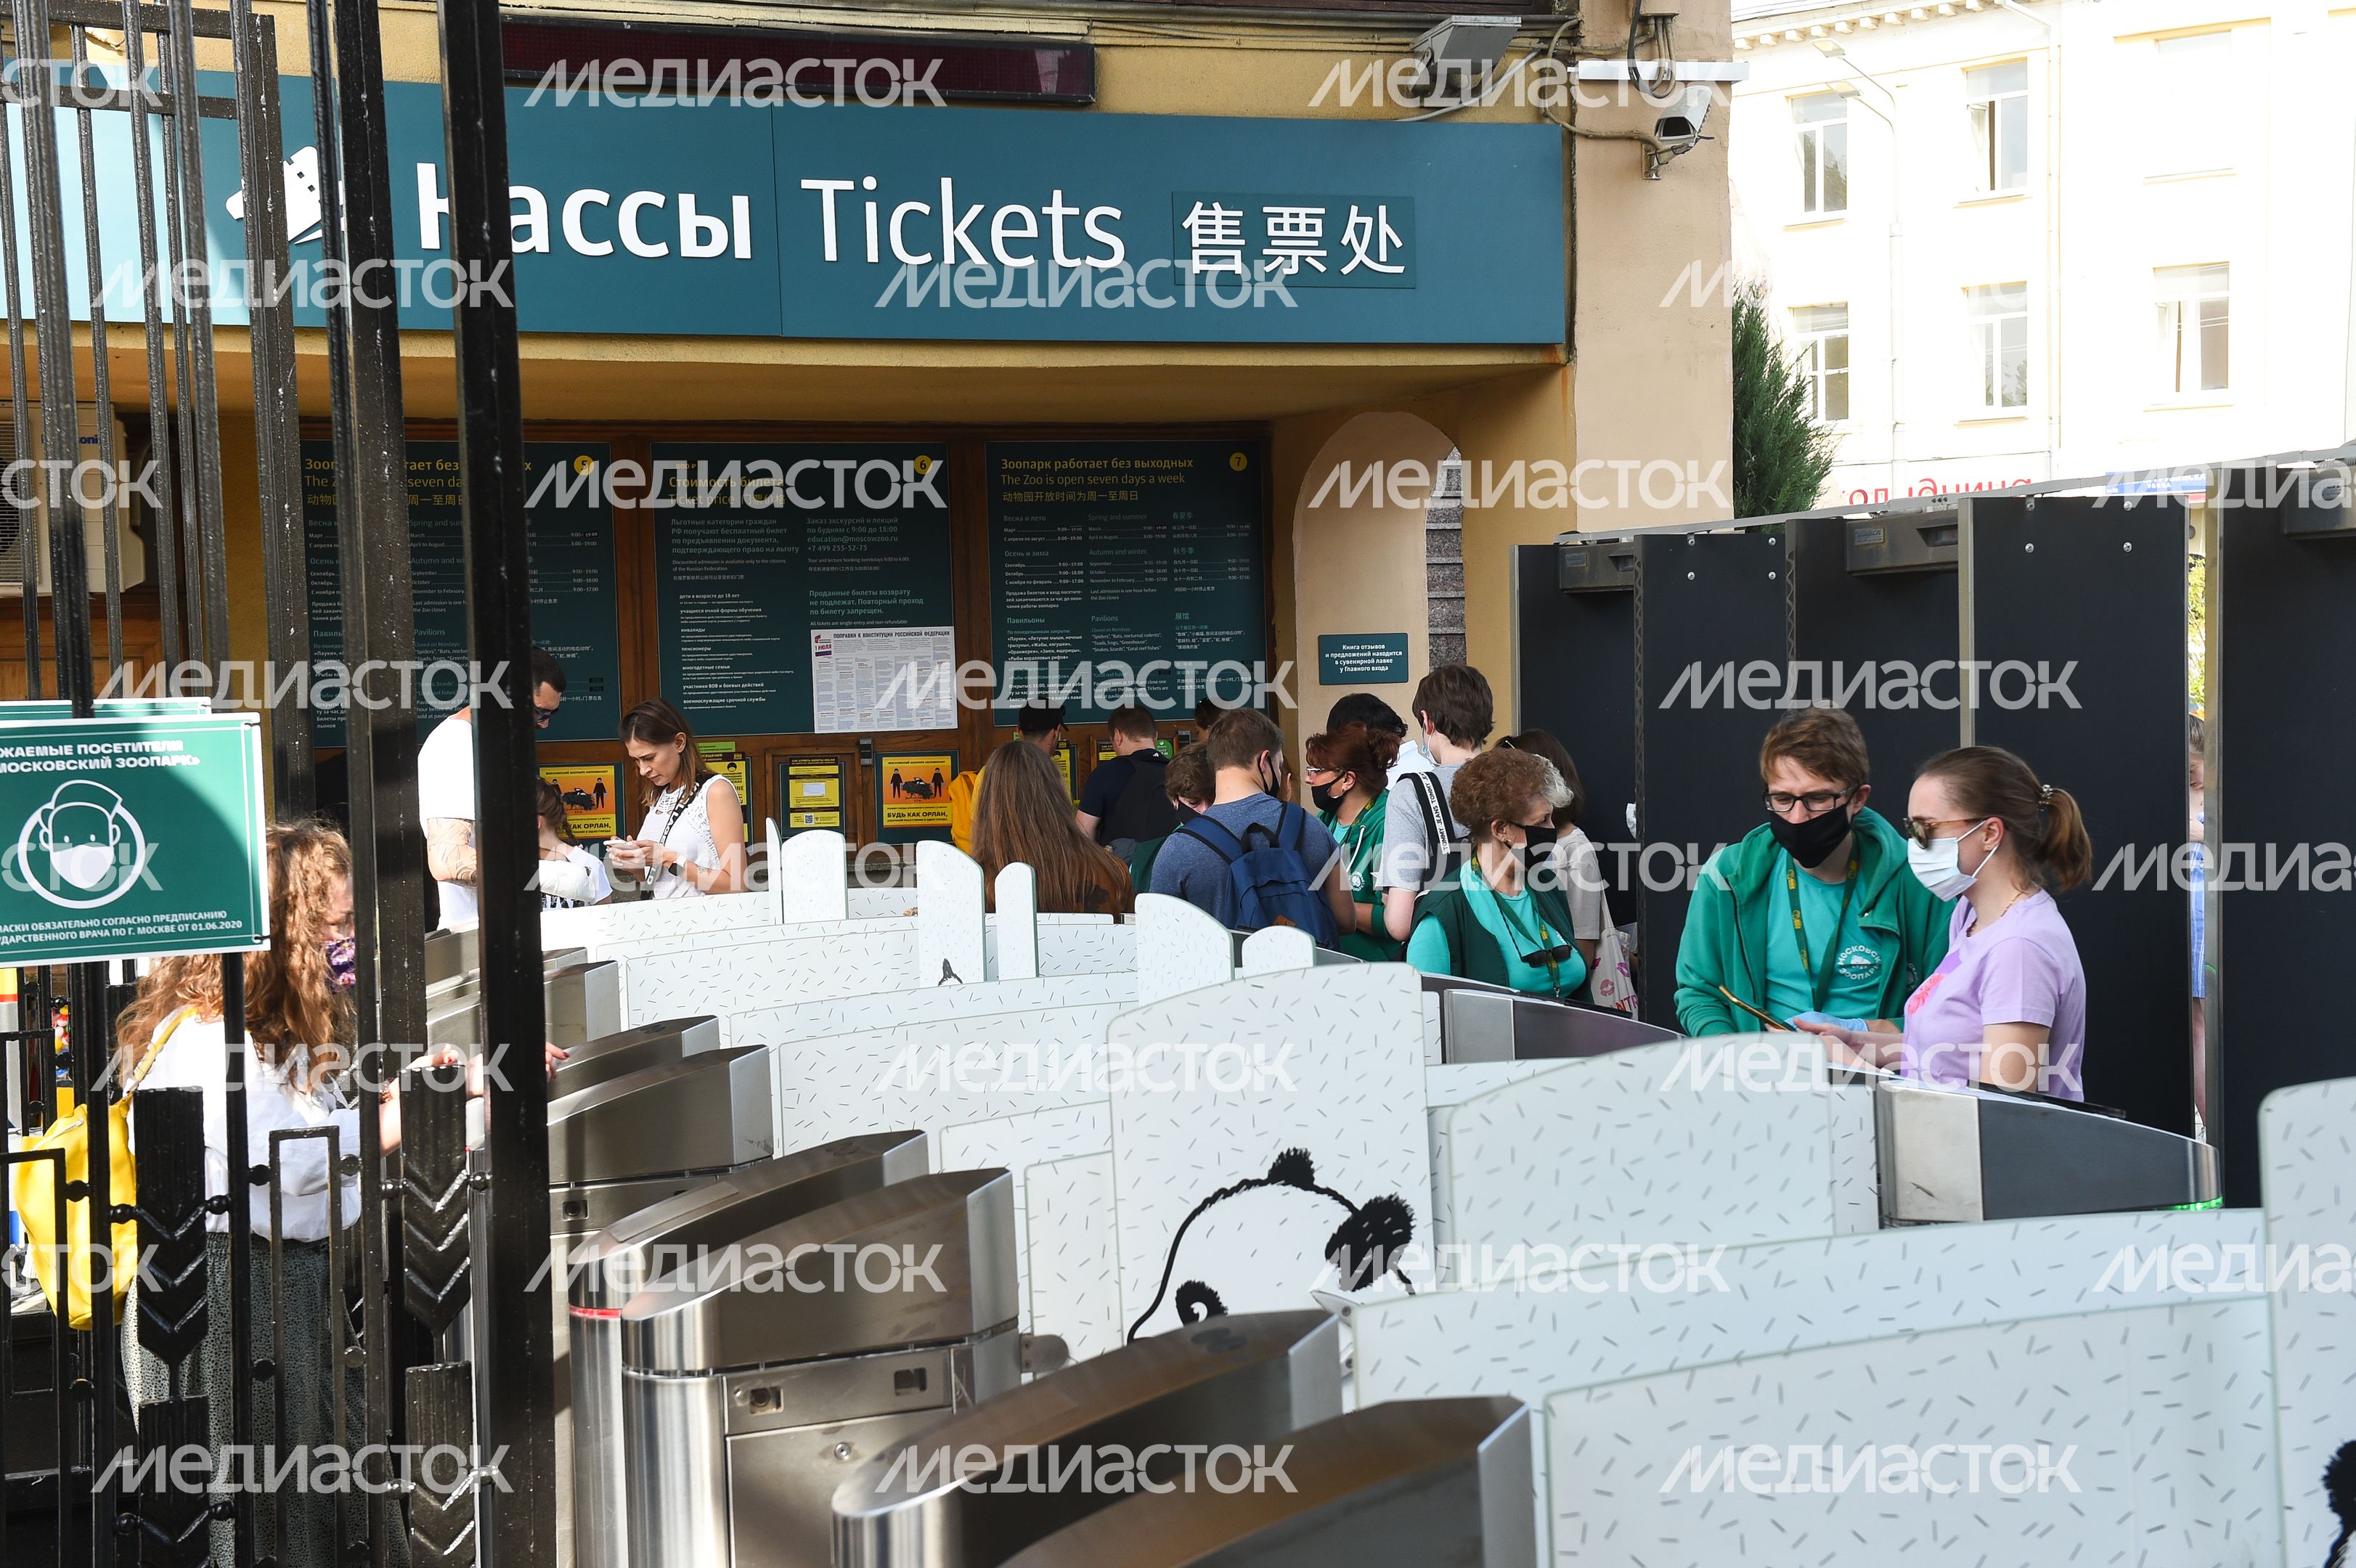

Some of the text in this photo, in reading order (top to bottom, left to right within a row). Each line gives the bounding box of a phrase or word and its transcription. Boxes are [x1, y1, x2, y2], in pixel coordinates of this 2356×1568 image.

[801, 176, 1125, 267] Tickets
[1181, 202, 1406, 274] 售票处
[436, 459, 459, 471] без
[919, 460, 927, 470] 6
[1001, 457, 1193, 471] Зоопарк работает без выходных
[1234, 456, 1242, 467] 7
[305, 475, 327, 487] The
[408, 477, 444, 487] seven
[1000, 473, 1021, 484] The
[1022, 474, 1043, 484] Zoo
[1045, 473, 1054, 484] is
[1056, 475, 1084, 486] open
[1087, 475, 1118, 484] seven
[1121, 473, 1146, 486] days
[1157, 472, 1185, 483] week
[1002, 491, 1138, 502] 动物园开放时间为周一至周日
[1088, 513, 1108, 522] Spring
[77, 740, 184, 755] ПОСЕТИТЕЛИ
[115, 754, 201, 768] ЗООПАРК»
[1424, 782, 1448, 850] TOMMY JEANS TOMMY
[31, 918, 99, 931] ОБЯЗАТЕЛЬНО
[102, 915, 151, 927] СОГЛАСНО
[153, 910, 227, 923] ПРЕДПИСАНИЮ
[79, 928, 110, 939] ВРАЧА
[113, 928, 126, 937] ПО
[128, 927, 136, 936] Г.
[137, 925, 176, 936] МОСКВЕ
[178, 923, 189, 932] ОТ
[191, 920, 242, 931] 01.06.2020
